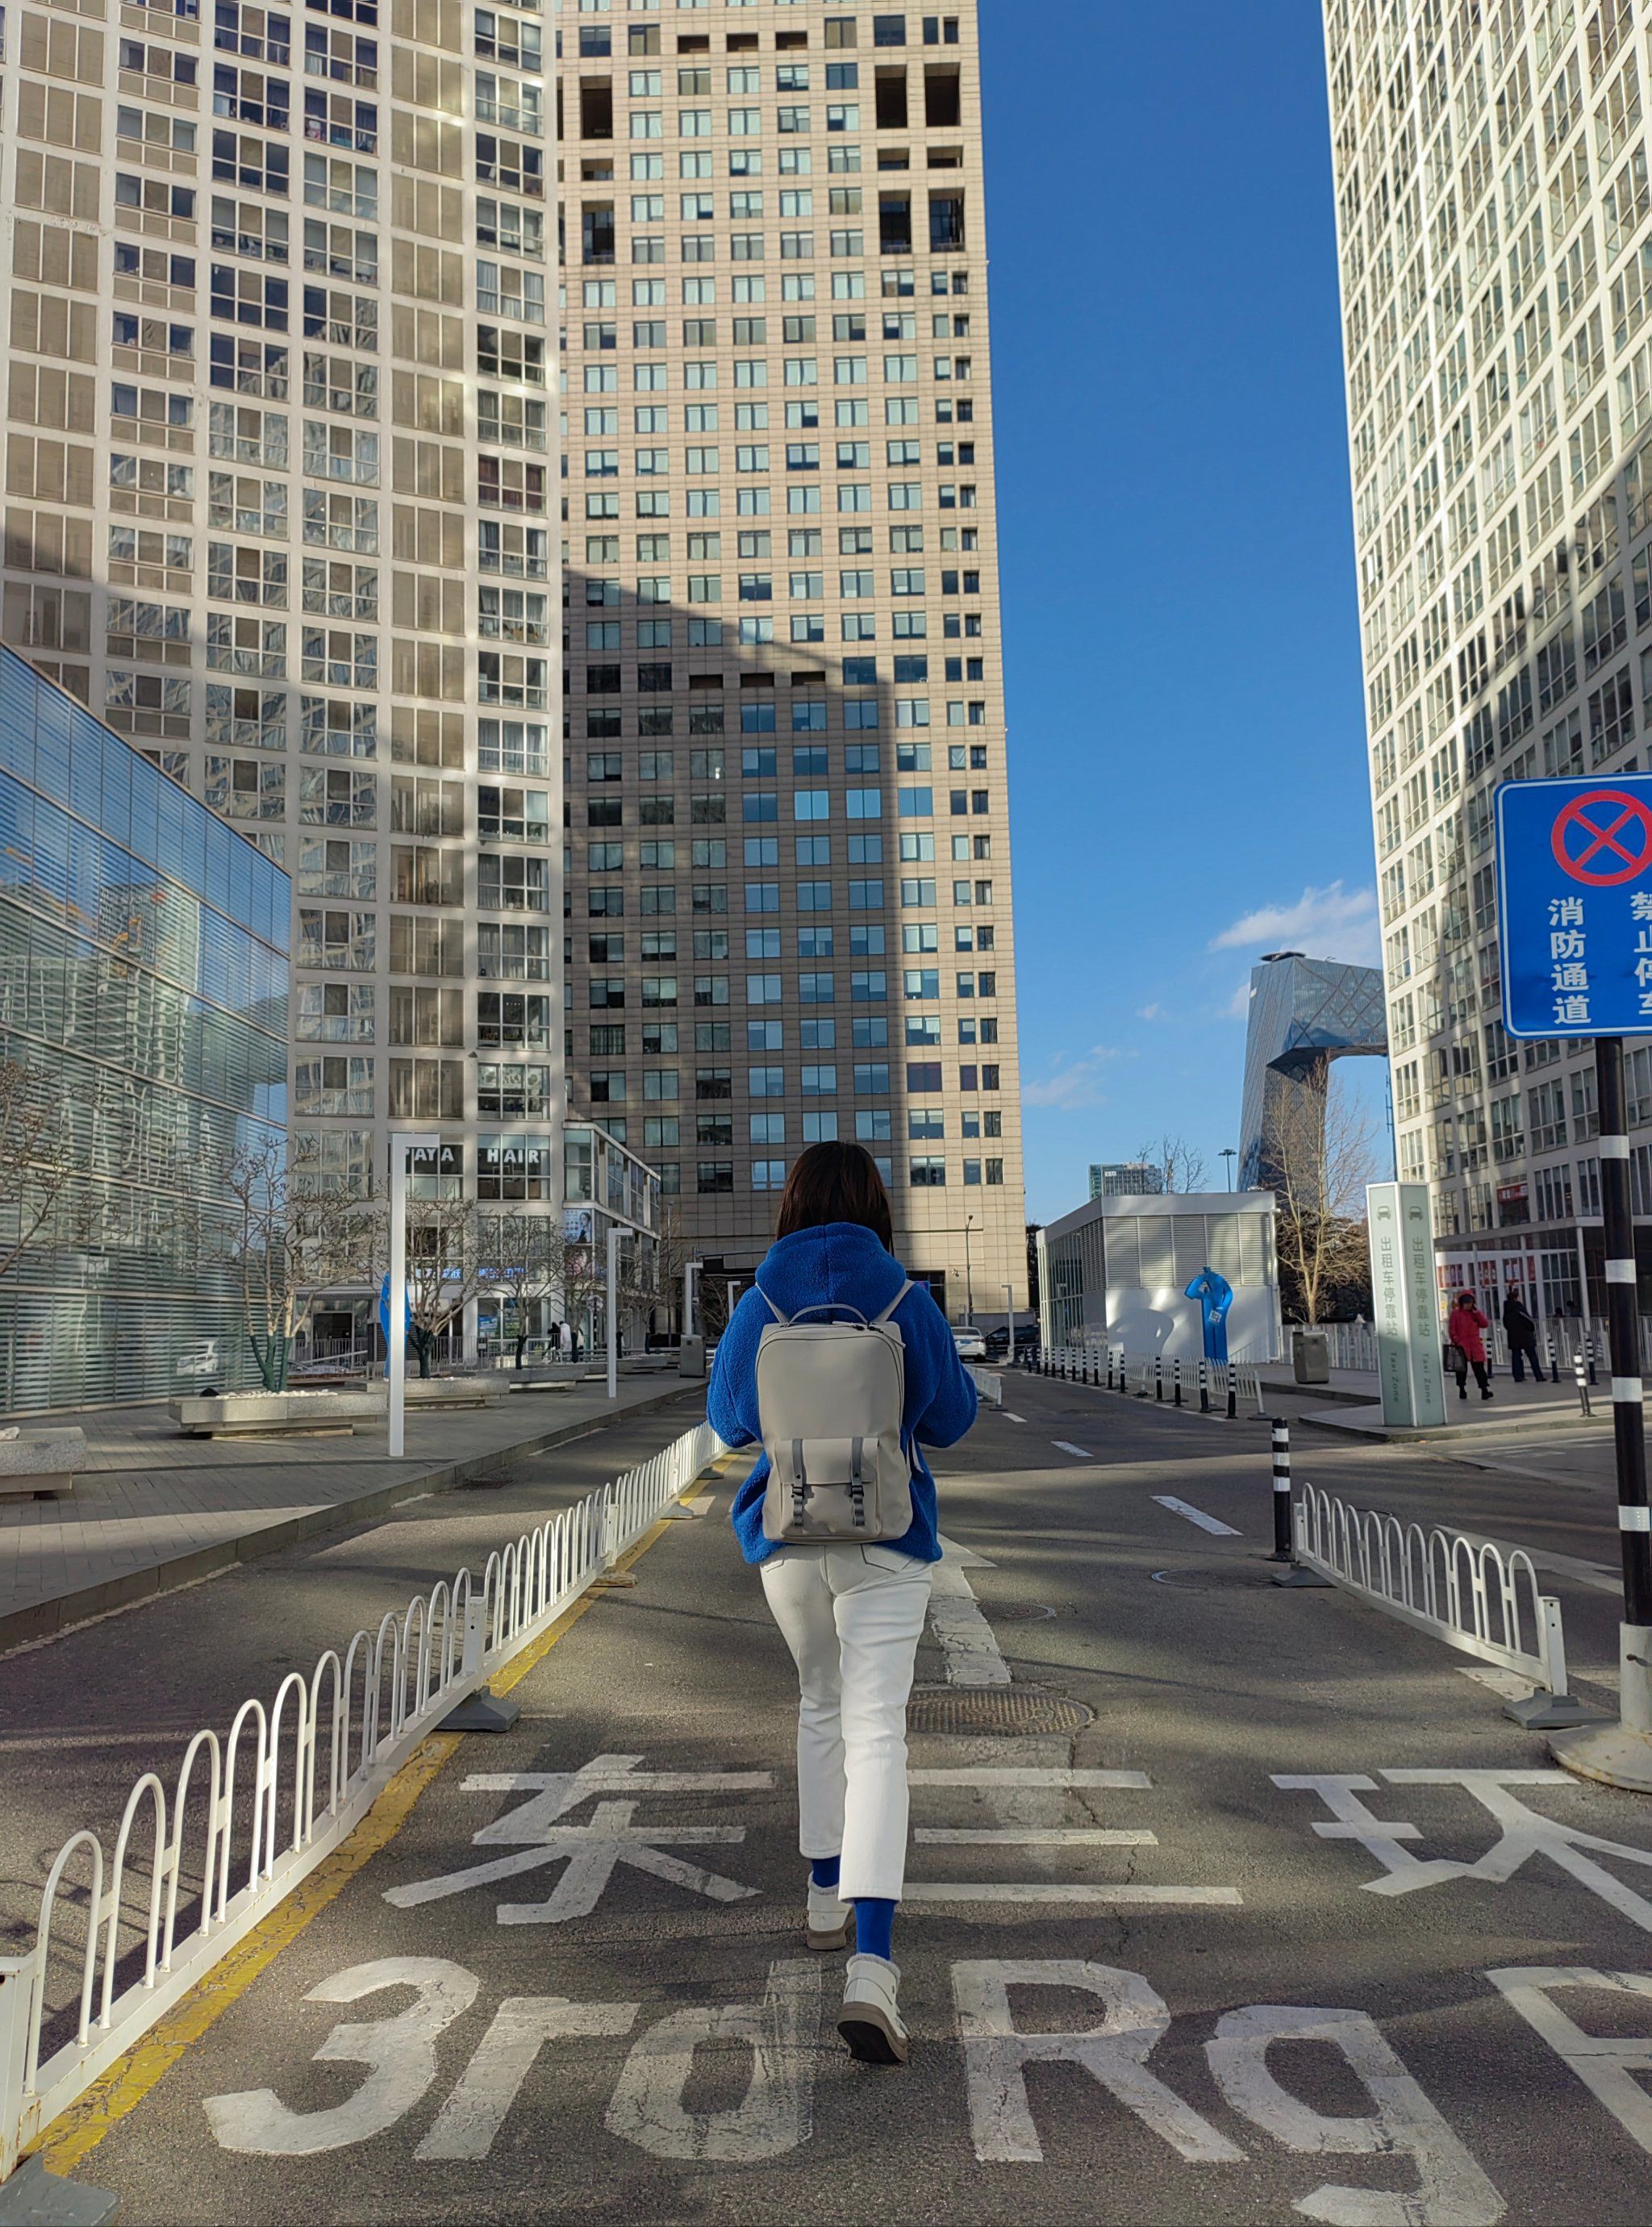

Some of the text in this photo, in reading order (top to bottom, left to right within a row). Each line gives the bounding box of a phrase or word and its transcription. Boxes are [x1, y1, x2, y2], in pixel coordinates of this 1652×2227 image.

[1547, 896, 1592, 1024] 消防通道
[487, 1149, 540, 1163] HAIR
[1380, 1236, 1398, 1337] 出租车停靠站
[1412, 1236, 1430, 1337] 出租车停靠站
[1390, 1352, 1400, 1403] Taxi Zone
[1424, 1378, 1432, 1404] Zone
[202, 1955, 823, 2163] 3rd
